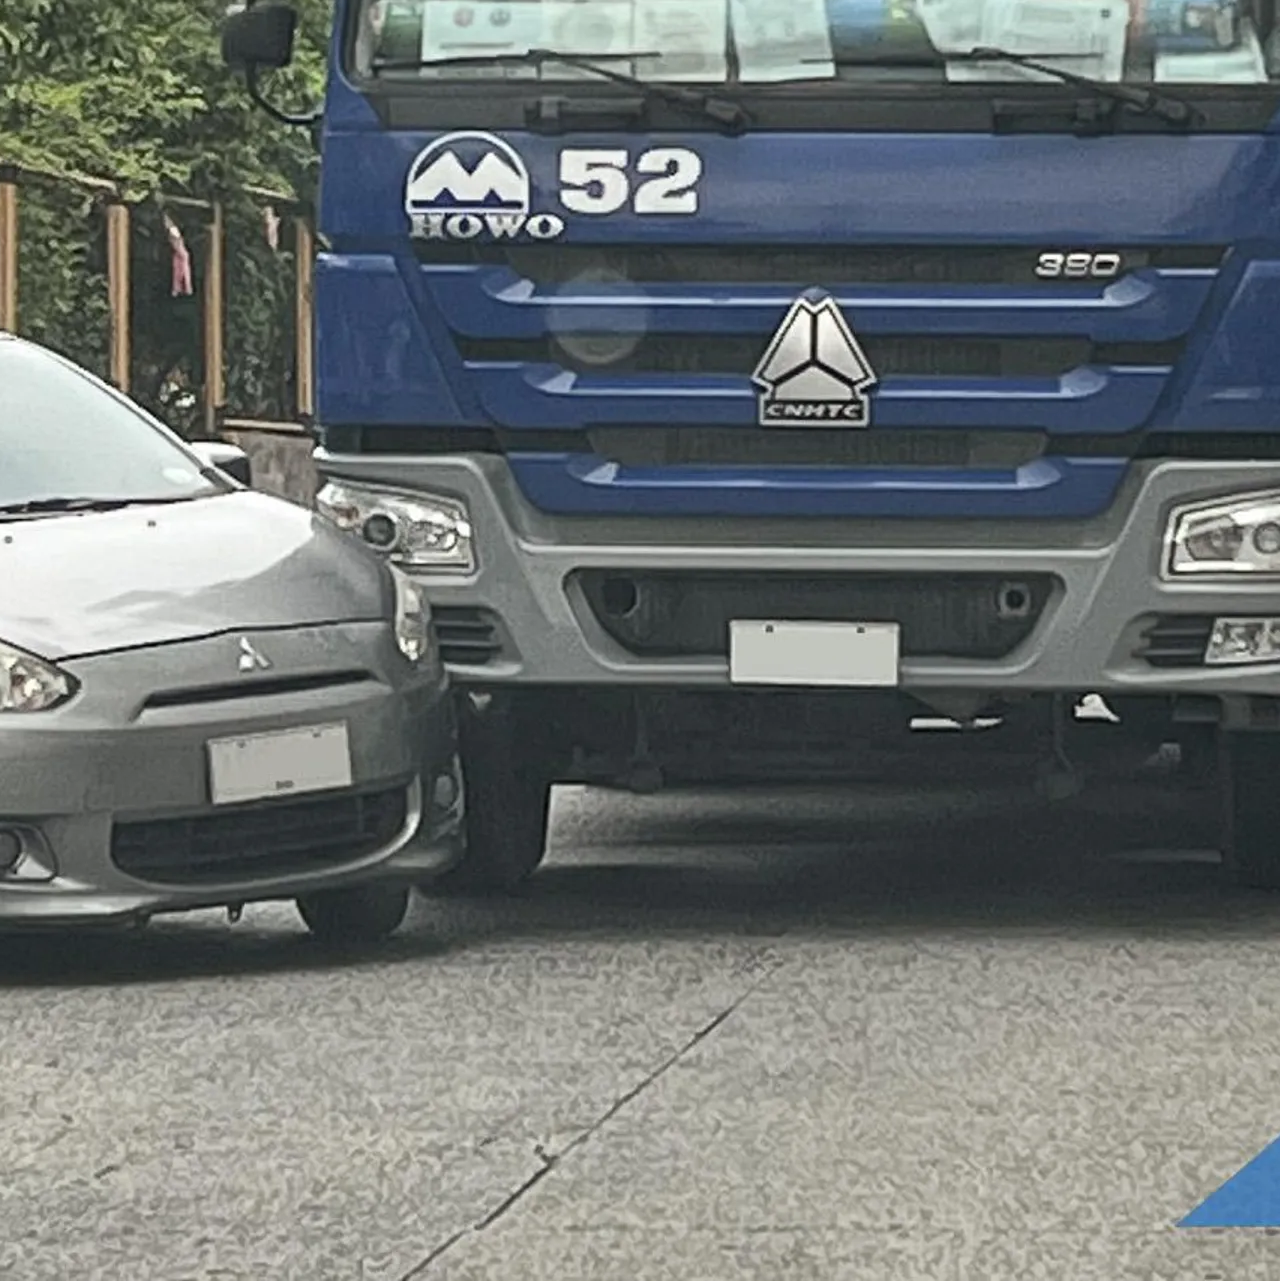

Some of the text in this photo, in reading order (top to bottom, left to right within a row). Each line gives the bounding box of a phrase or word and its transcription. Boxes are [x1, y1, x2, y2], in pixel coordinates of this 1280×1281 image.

[560, 147, 702, 214] 52
[408, 213, 566, 239] HOWO
[1035, 253, 1120, 276] 380
[766, 403, 861, 418] CNHTC
